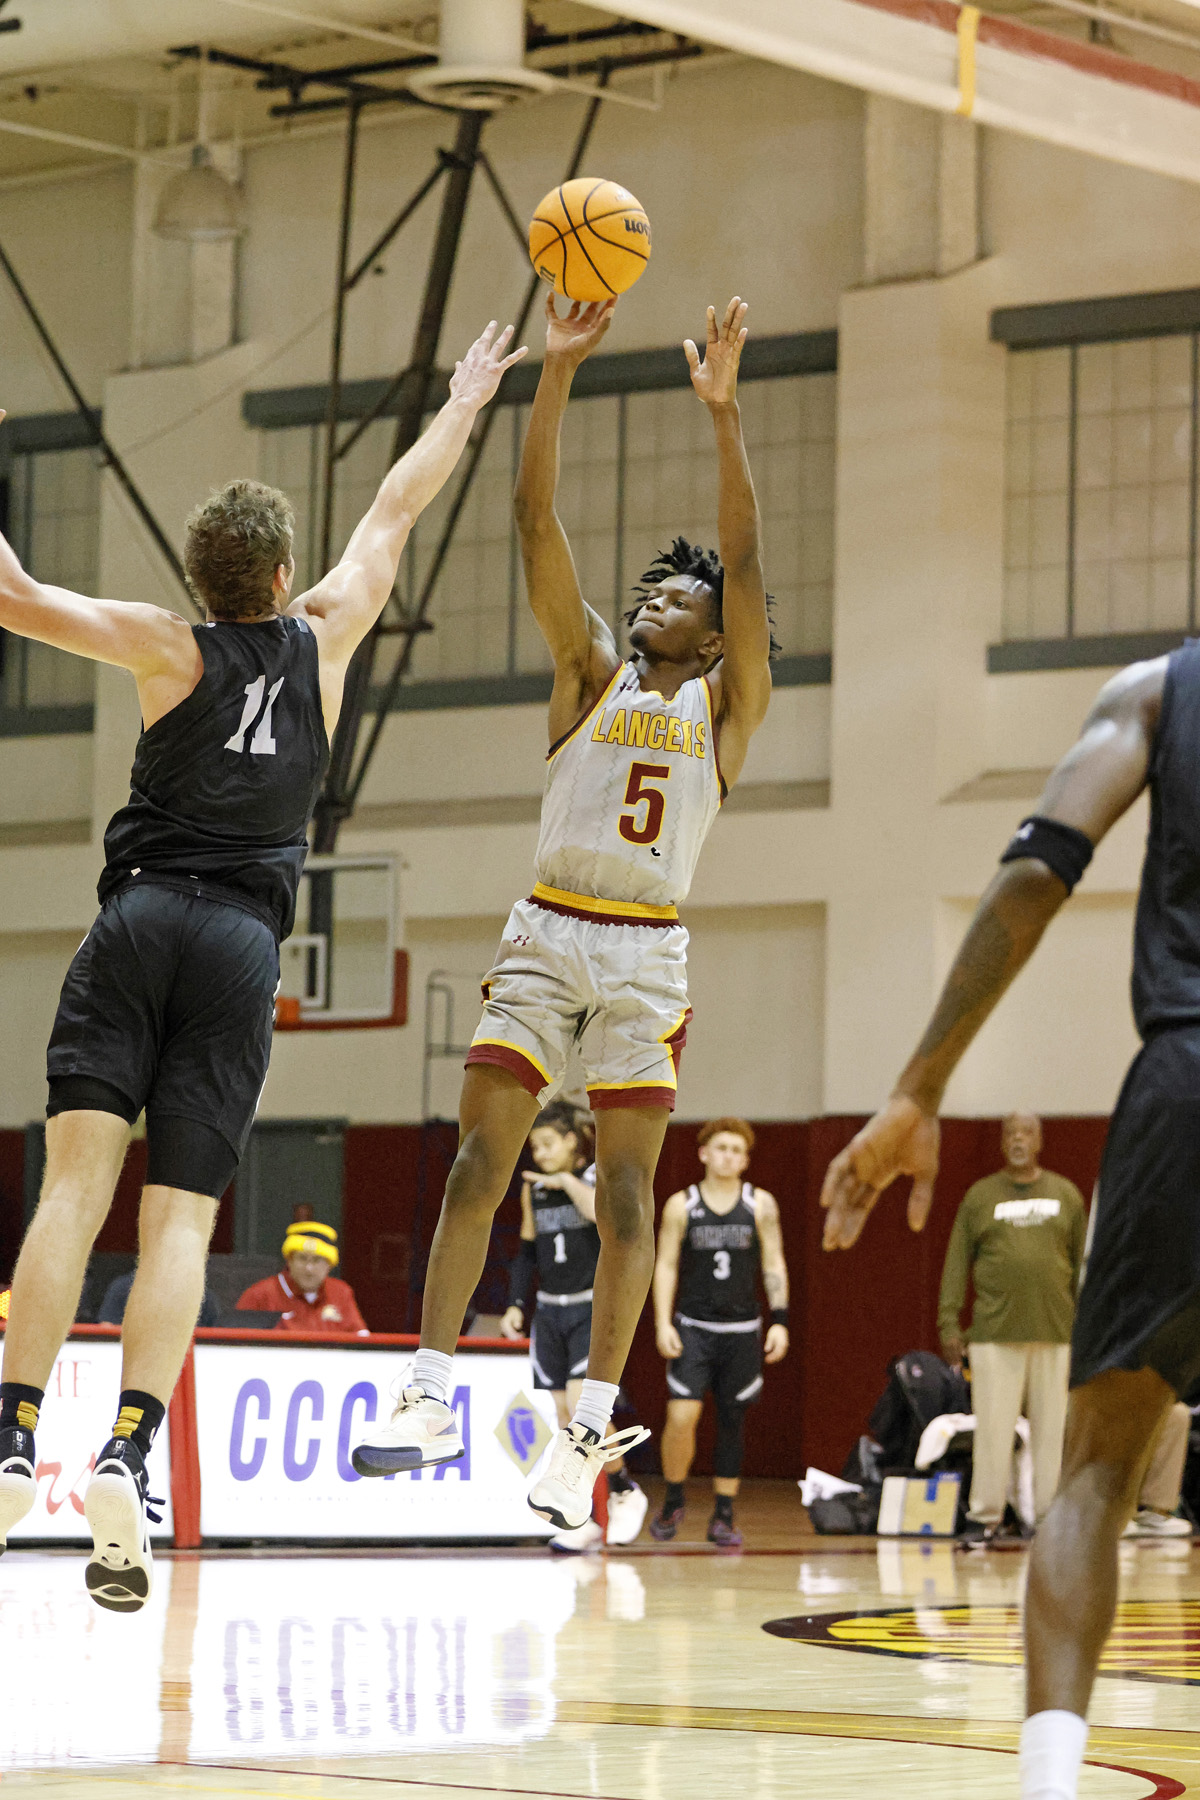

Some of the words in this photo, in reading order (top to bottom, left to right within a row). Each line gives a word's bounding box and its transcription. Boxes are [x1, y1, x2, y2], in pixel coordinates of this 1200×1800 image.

[223, 674, 285, 755] 11
[591, 708, 706, 760] LANCERS
[617, 760, 672, 846] 5
[553, 1232, 568, 1264] 1
[712, 1250, 731, 1280] 3
[229, 1378, 471, 1482] CCCA
